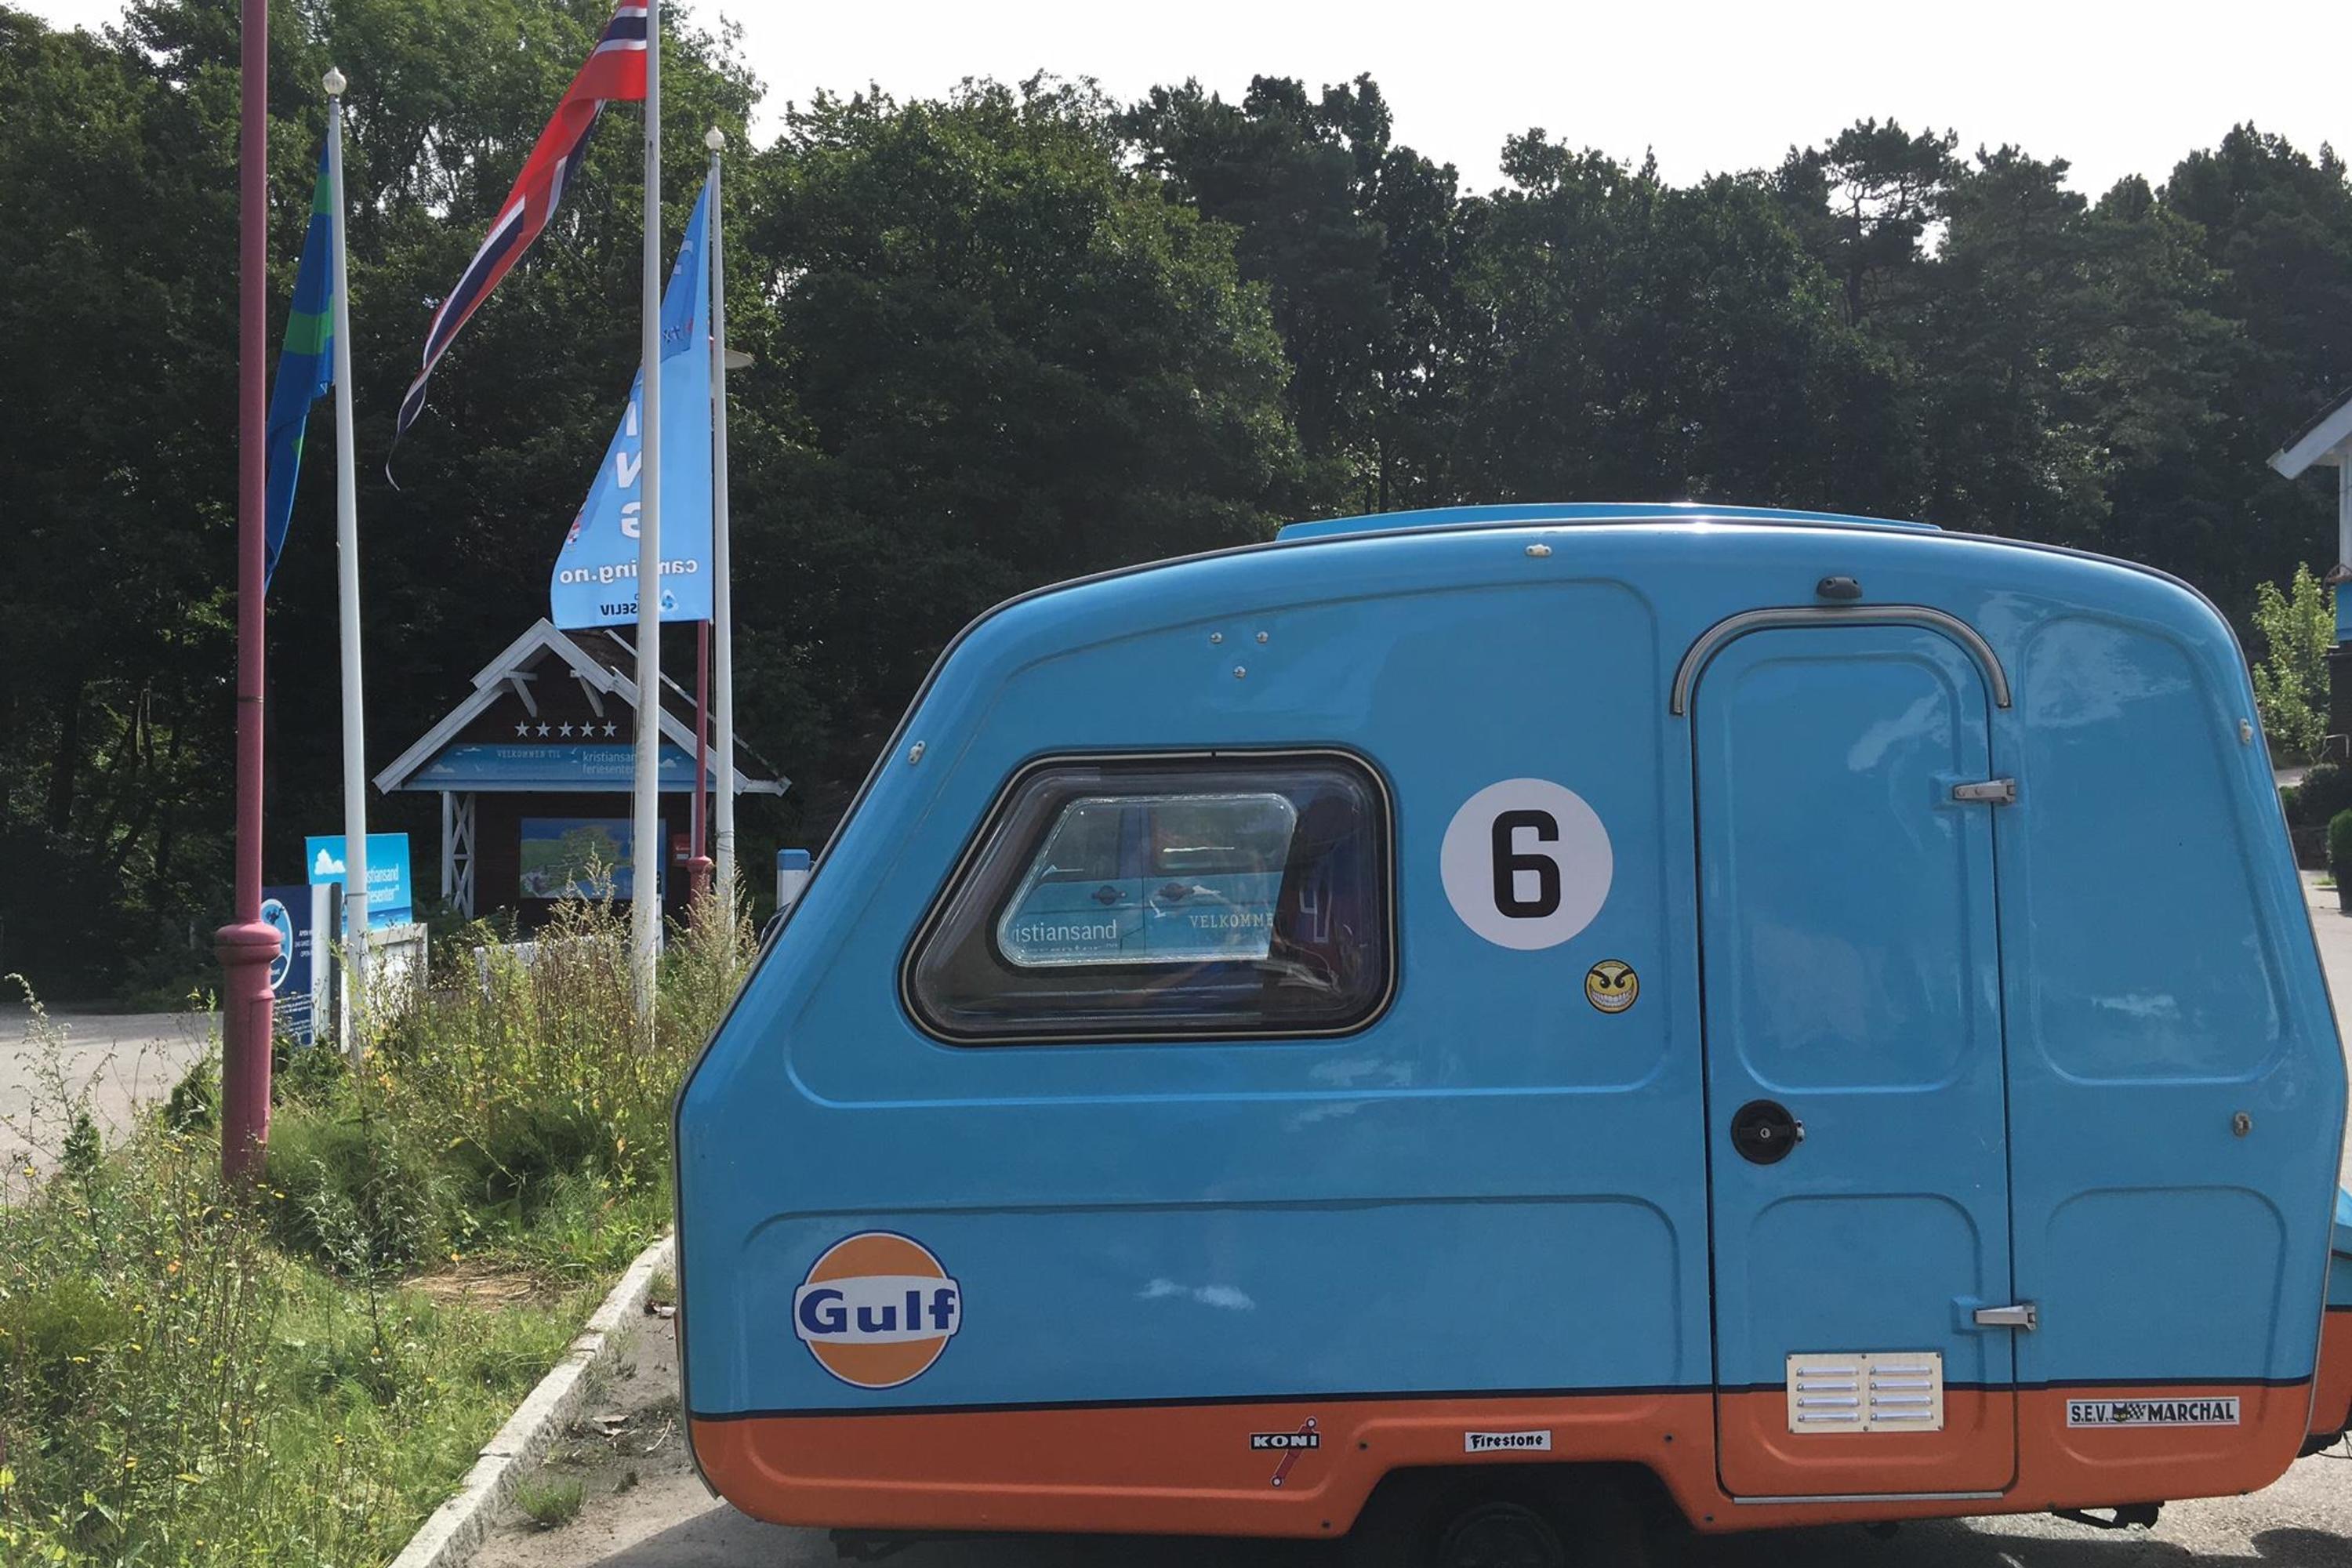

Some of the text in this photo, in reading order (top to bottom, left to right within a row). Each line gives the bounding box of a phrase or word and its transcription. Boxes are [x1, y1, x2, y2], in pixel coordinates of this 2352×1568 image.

[583, 750, 637, 763] kristiansan
[1491, 809, 1561, 919] 6
[1189, 913, 1274, 928] VELKOMME
[1015, 919, 1117, 942] istiansand
[799, 1287, 956, 1334] Gulf
[2071, 1402, 2234, 1422] S.E.V. MARCHAL
[1254, 1436, 1317, 1447] KONI
[1470, 1435, 1543, 1450] Firestone
